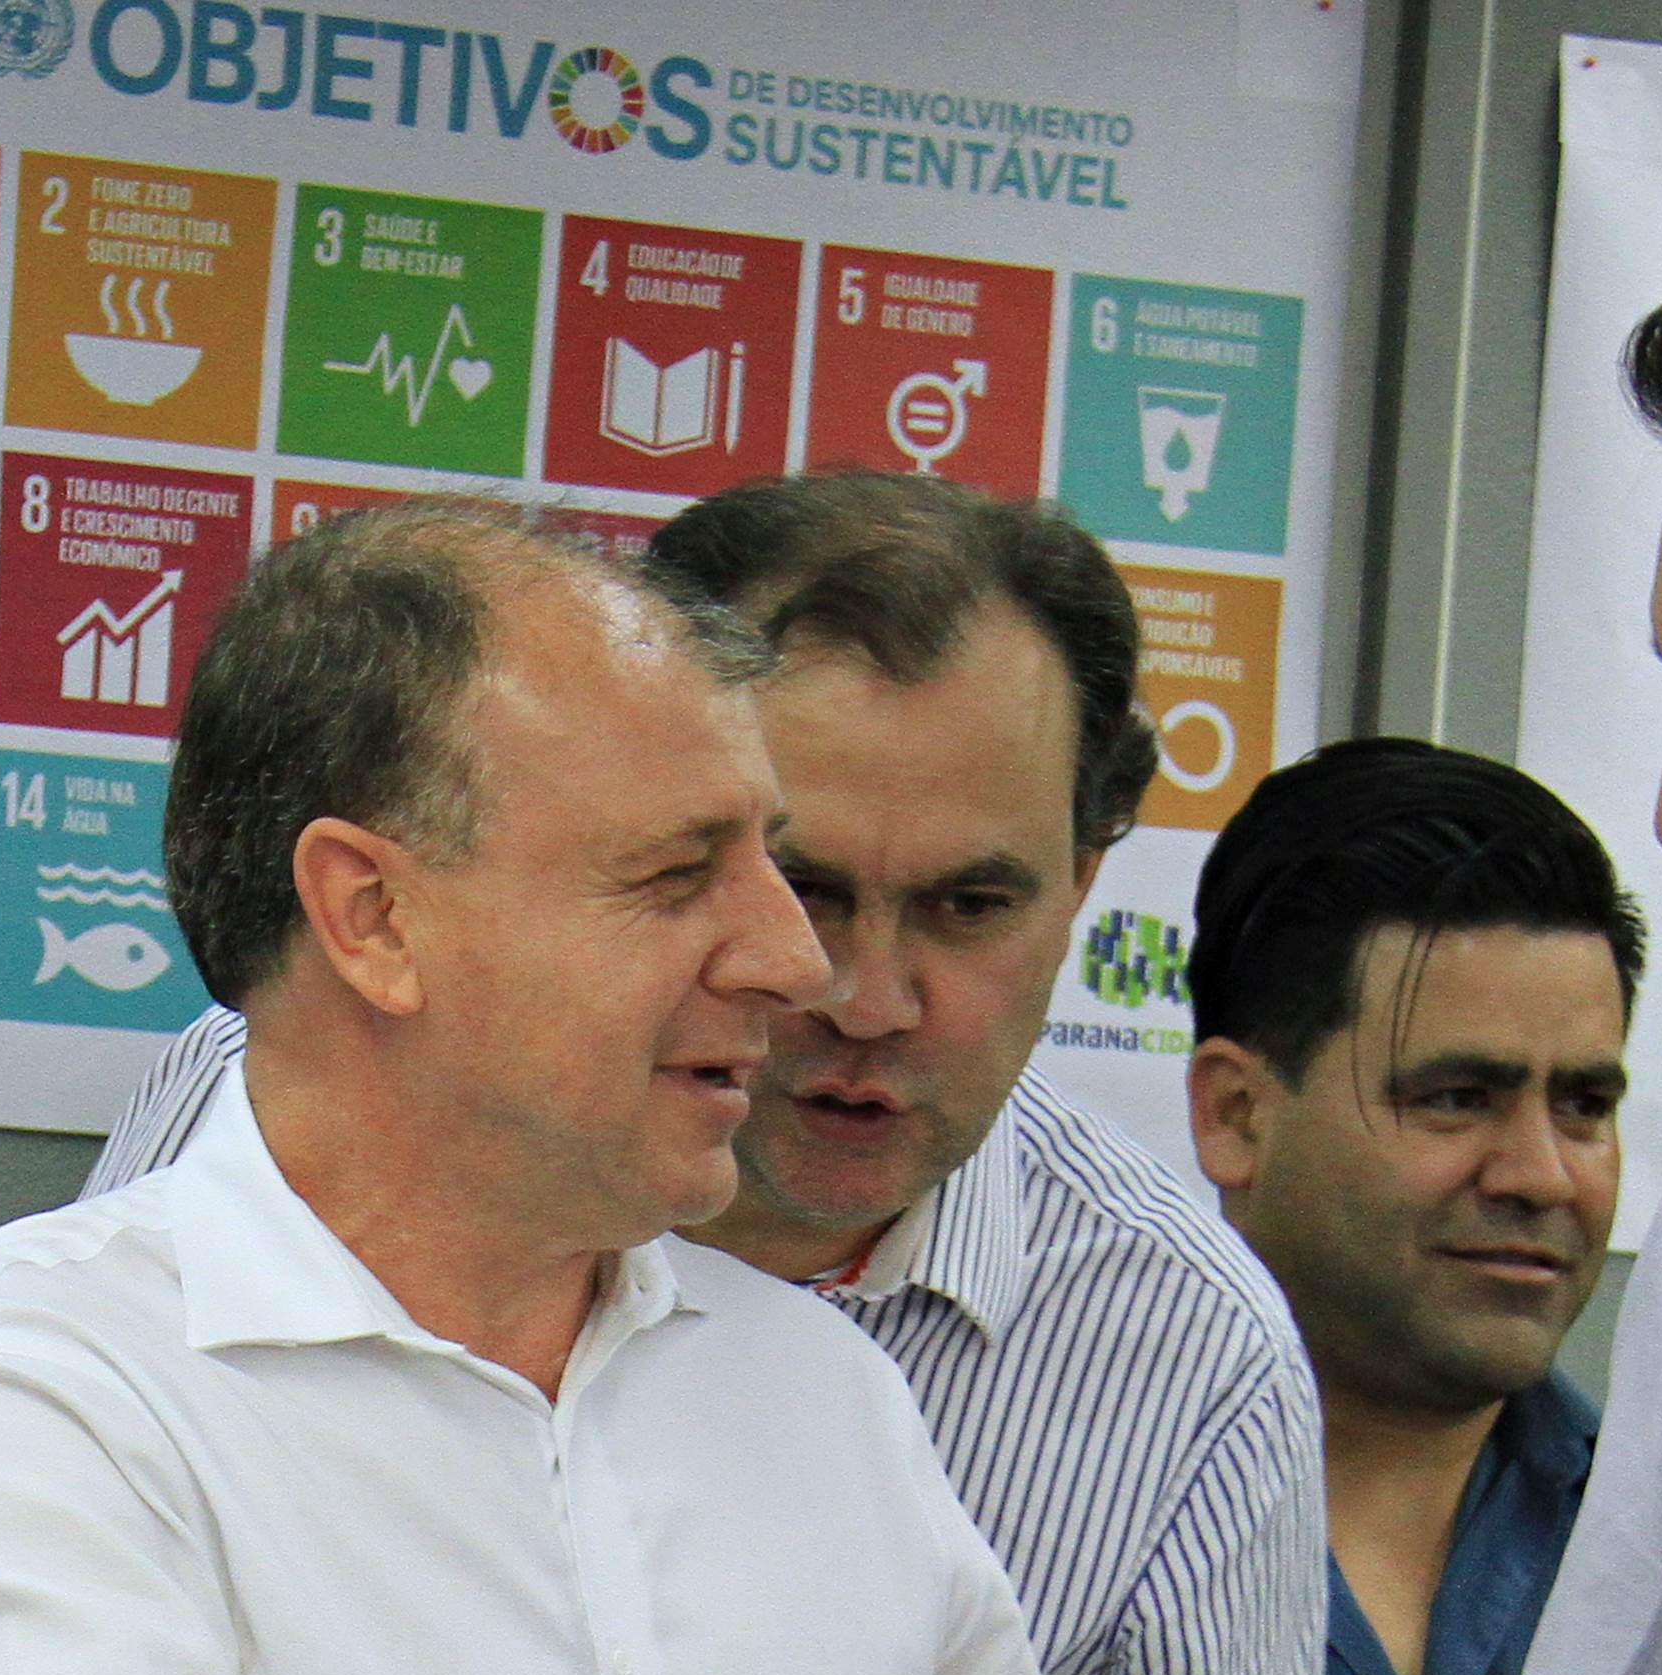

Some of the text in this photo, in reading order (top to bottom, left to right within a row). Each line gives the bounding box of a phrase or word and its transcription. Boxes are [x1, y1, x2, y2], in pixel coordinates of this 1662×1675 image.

[89, 0, 1134, 160] OBJETIVOS DE DESENVOLVIMENTO
[725, 113, 1127, 209] SUSTENTÁVEL
[41, 175, 70, 235] 2
[89, 207, 232, 246] E AGRICULTURA
[315, 207, 344, 266] 3
[364, 212, 437, 245] SAÚDE E
[87, 237, 214, 276] SUSTENTÁVEL
[360, 246, 464, 279] BEM-ESTAR
[579, 240, 609, 296] 4
[628, 243, 719, 275] EDUCAÇÃO
[625, 275, 722, 310] QUALIDADE
[838, 268, 865, 325] 5
[884, 273, 979, 307] IGUALDADE
[881, 304, 903, 329] DE
[1092, 297, 1117, 351] 6
[21, 474, 51, 533] 8
[65, 476, 240, 519] TRABALHO DECENTE
[60, 508, 196, 545] E CRESCIMENTO
[1, 771, 46, 830] 14
[65, 776, 107, 802] VIDA
